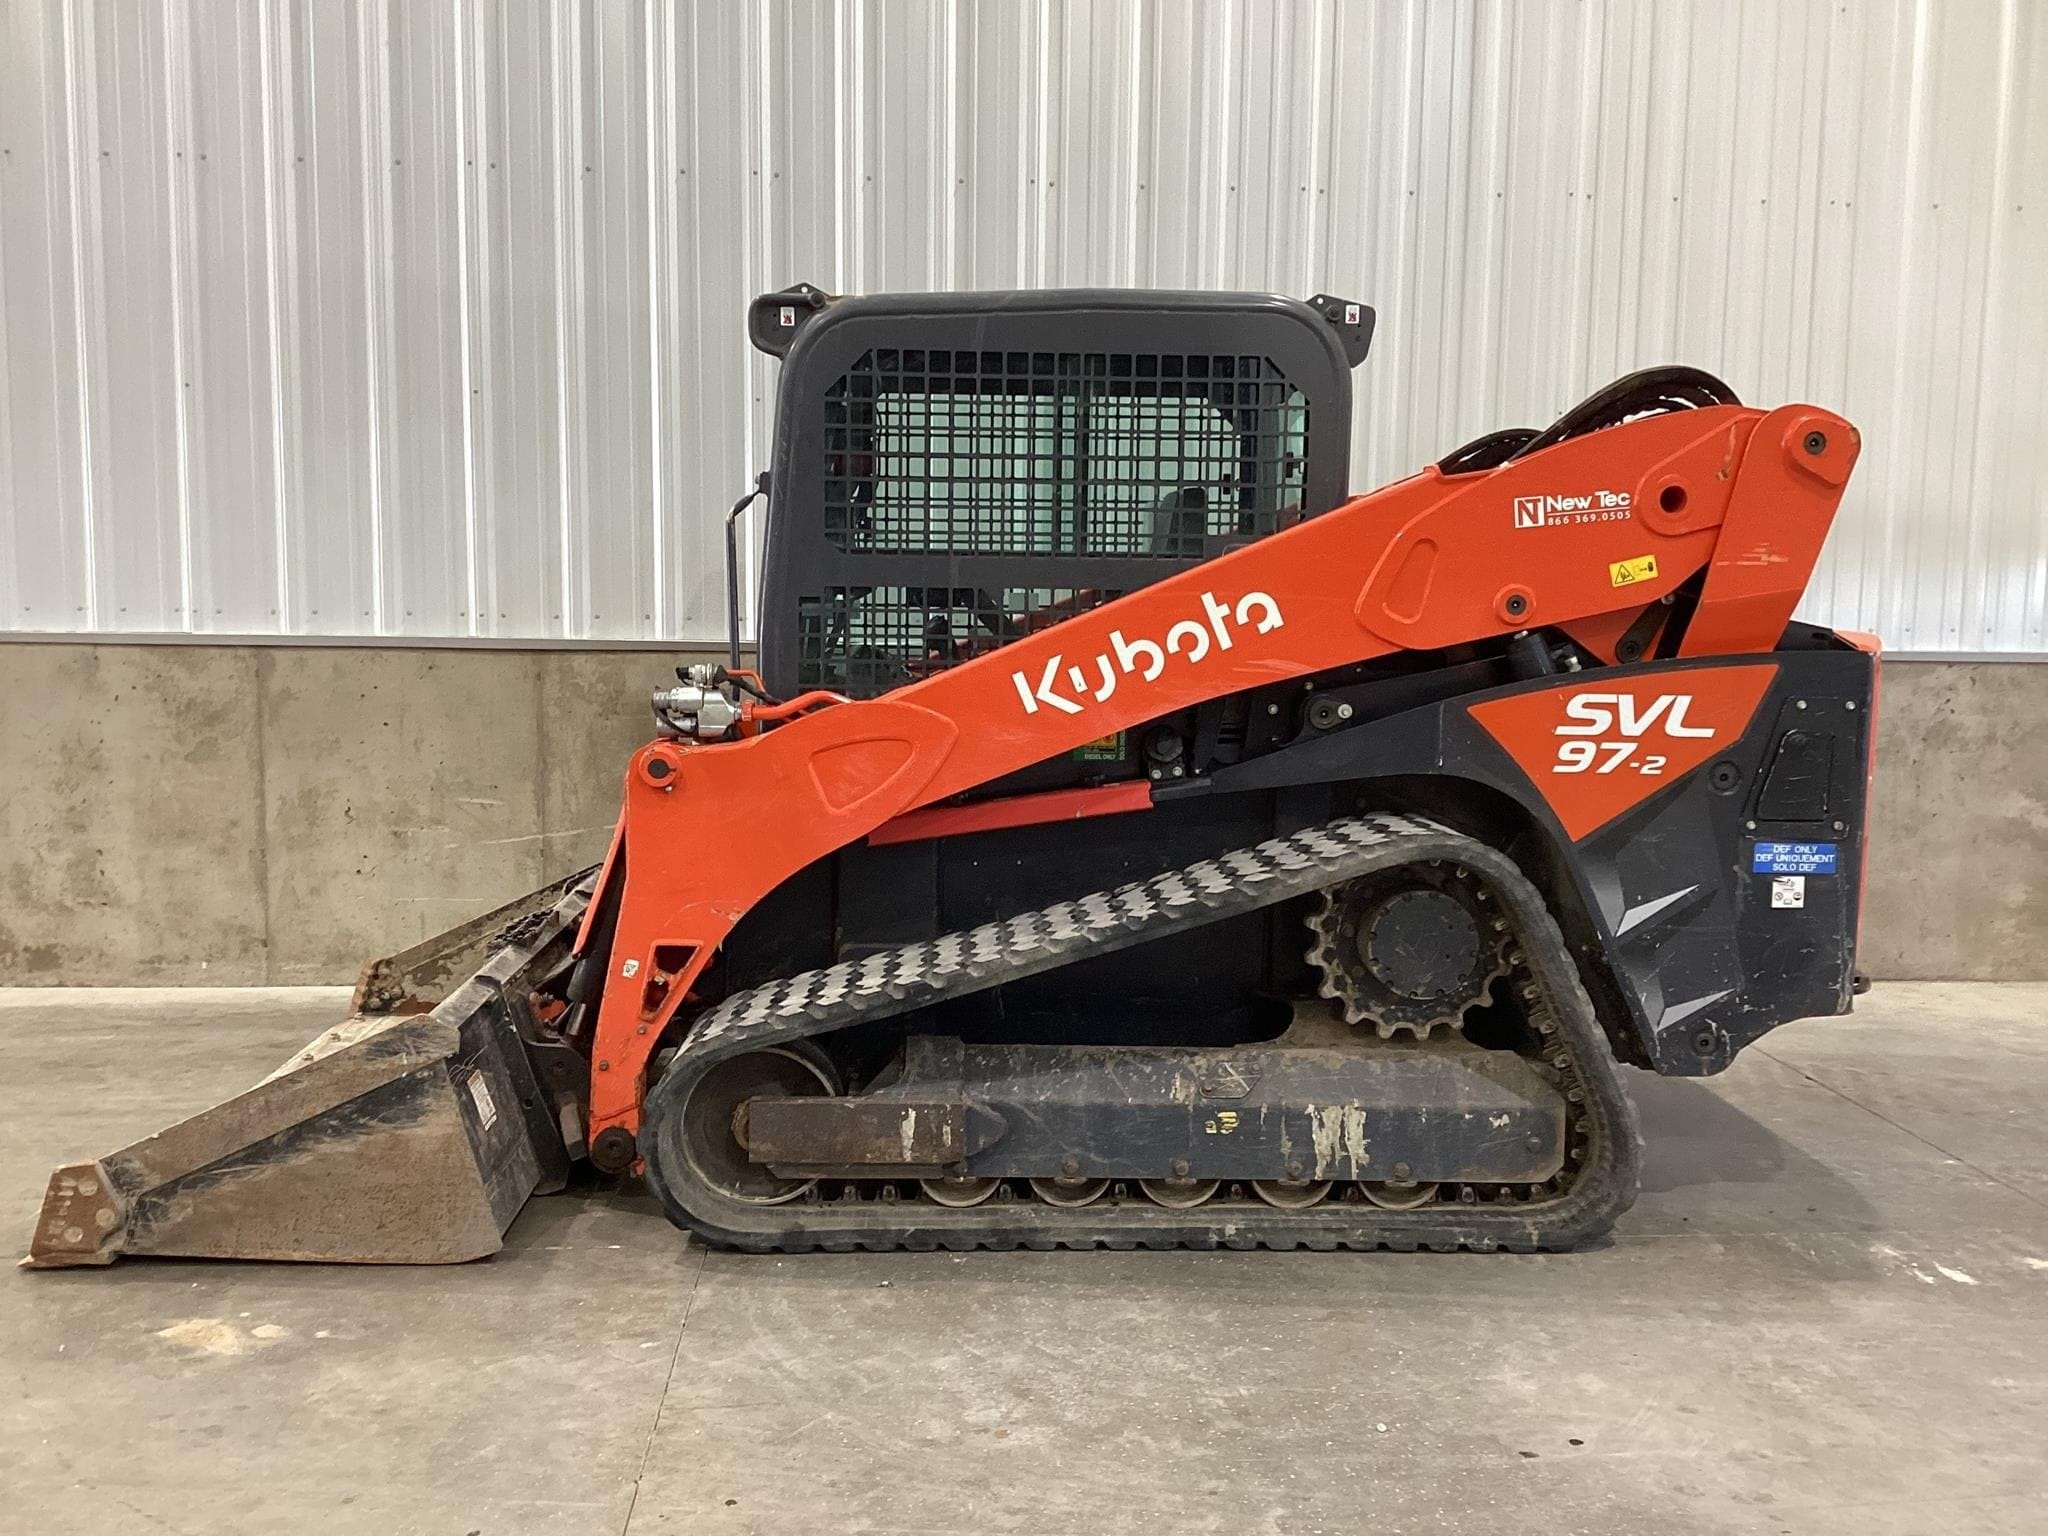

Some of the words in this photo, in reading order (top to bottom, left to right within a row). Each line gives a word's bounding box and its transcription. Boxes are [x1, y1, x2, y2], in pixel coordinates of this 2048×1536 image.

[1546, 495, 1592, 512] New
[1595, 490, 1631, 508] Tec
[1547, 516, 1570, 526] 866
[1575, 511, 1631, 524] 369.0505
[1012, 592, 1284, 715] Kubota
[1554, 694, 1715, 738] SVL
[1552, 742, 1667, 775] 97-2
[1755, 853, 1773, 862] DEF
[1776, 854, 1835, 863] UNIQUEMENT
[1773, 844, 1791, 853] DEF
[1794, 845, 1818, 854] ONLY
[1772, 863, 1797, 871] SOLO
[1799, 863, 1817, 872] DEF
